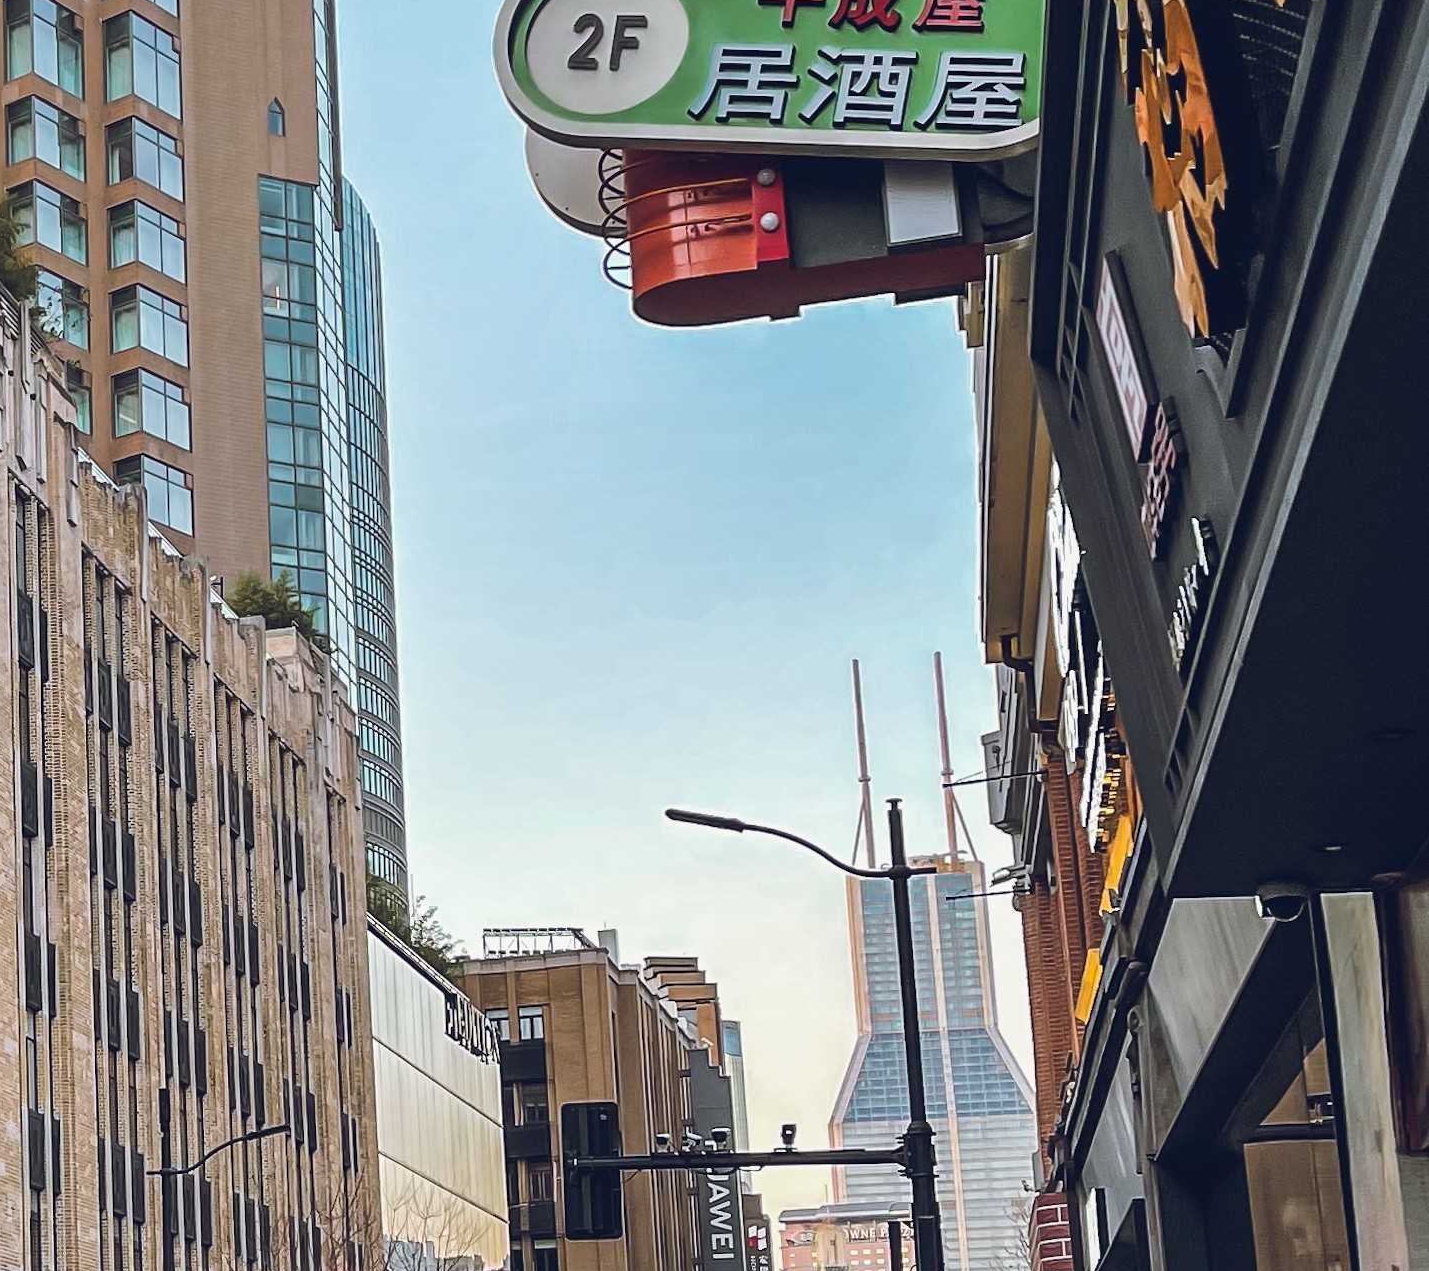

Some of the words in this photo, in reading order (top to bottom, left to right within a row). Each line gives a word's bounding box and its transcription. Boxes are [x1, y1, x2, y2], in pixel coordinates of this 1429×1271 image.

[566, 12, 649, 73] 2F
[687, 42, 1029, 129] 居酒屋
